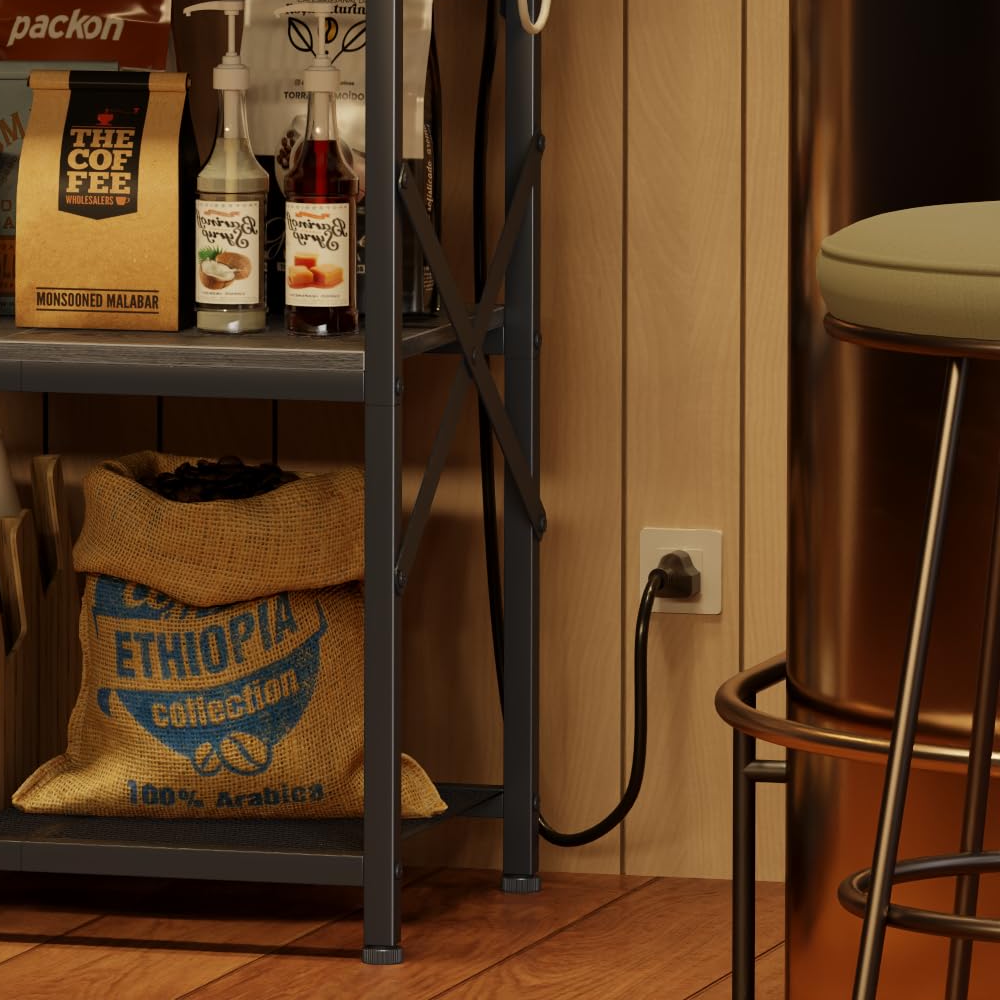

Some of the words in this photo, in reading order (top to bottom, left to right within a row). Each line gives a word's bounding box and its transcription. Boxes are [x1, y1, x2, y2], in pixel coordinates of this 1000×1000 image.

[6, 8, 125, 48] packon
[70, 128, 136, 149] THE
[67, 148, 133, 171] COF
[65, 170, 132, 194] FEE
[65, 195, 114, 206] WHOLESALERS
[36, 291, 103, 308] MONSOONED
[106, 293, 159, 310] MALABAR
[114, 592, 299, 680] ETHIOPIA
[151, 668, 300, 729] collection
[127, 780, 204, 808] 100%
[215, 783, 324, 809] Arabica
